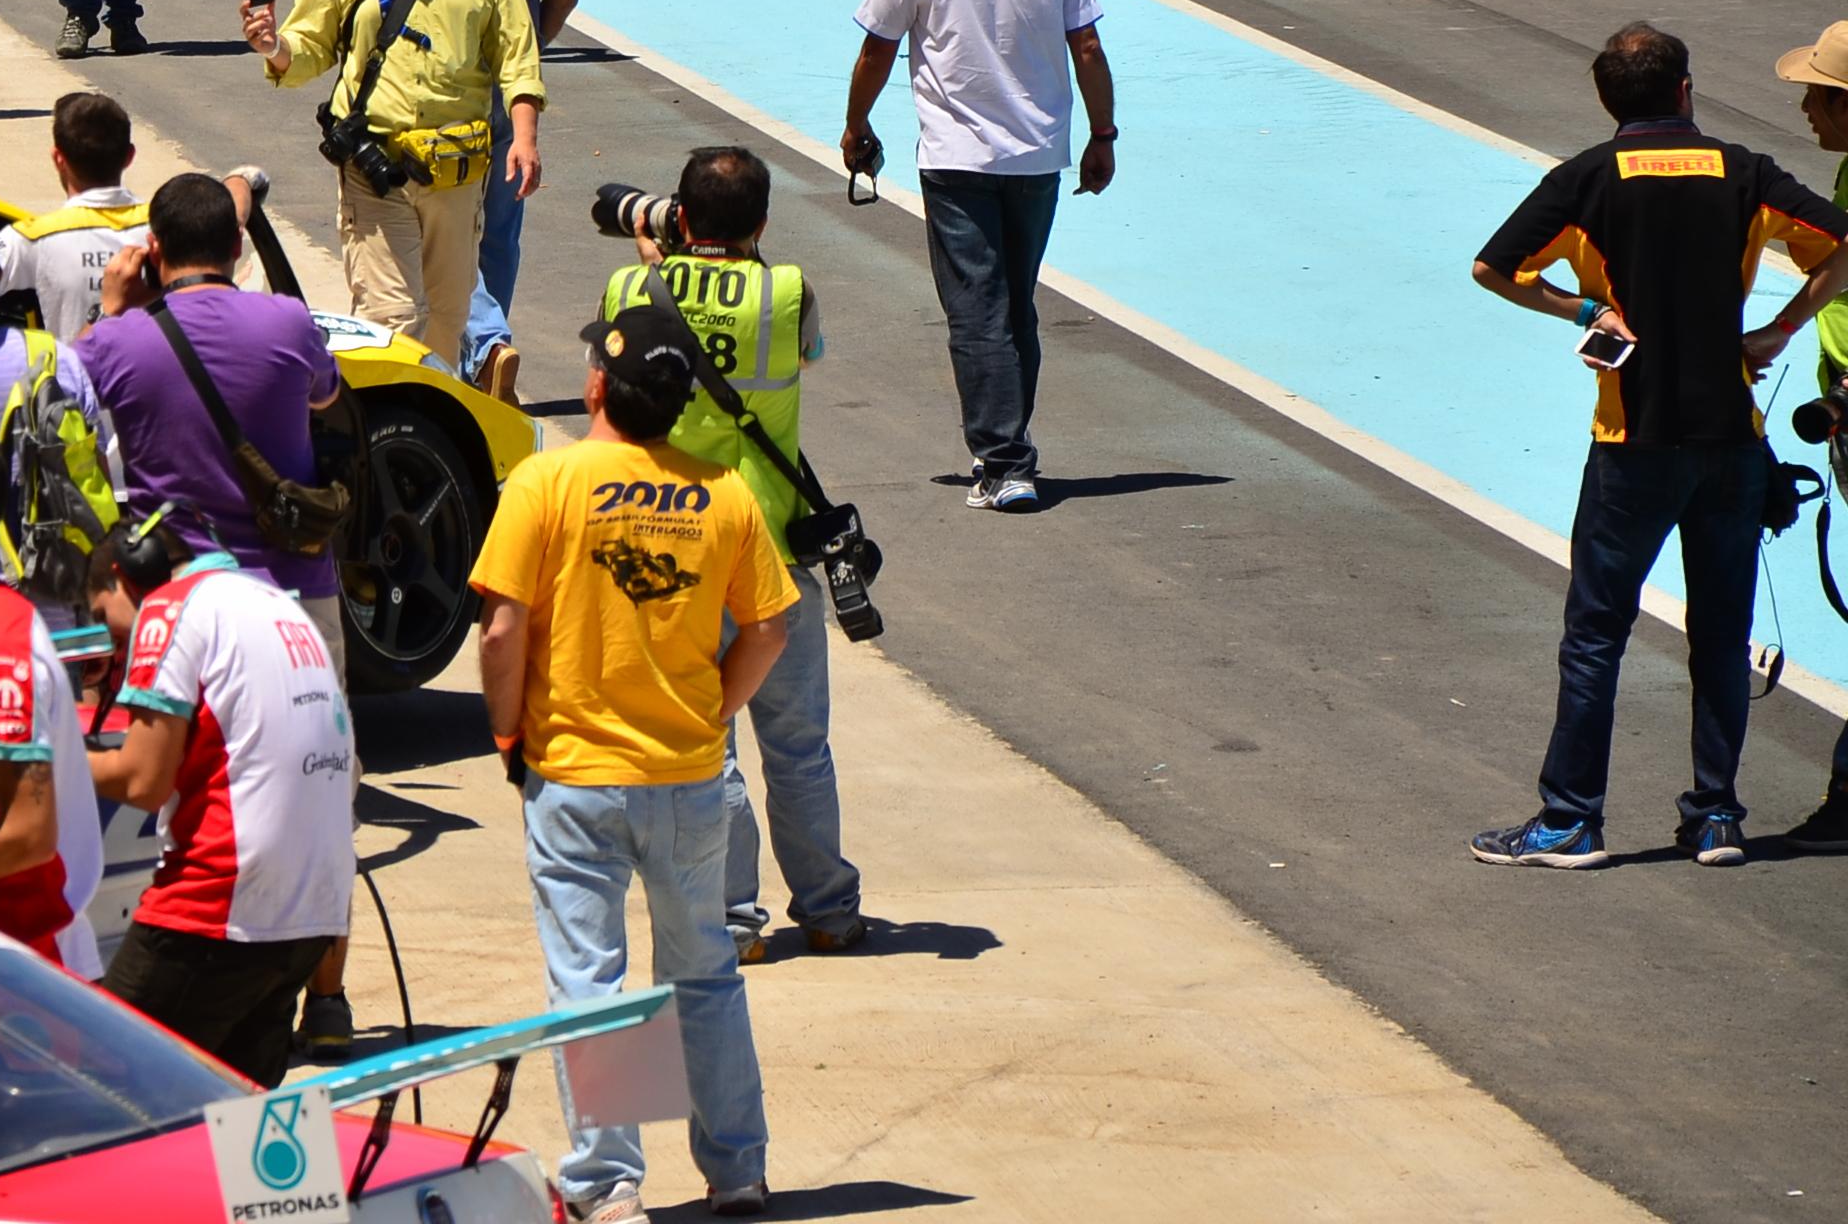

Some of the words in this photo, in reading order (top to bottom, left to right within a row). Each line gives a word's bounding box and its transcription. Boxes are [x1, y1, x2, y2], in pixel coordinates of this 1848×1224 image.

[1627, 154, 1718, 174] PIRELLI
[691, 245, 726, 256] Canon
[591, 480, 712, 514] 2010
[633, 523, 703, 537] INTERLAGOS
[274, 619, 327, 670] FIAT
[292, 690, 330, 708] PETRONAS
[232, 1193, 340, 1221] PETRONAS
